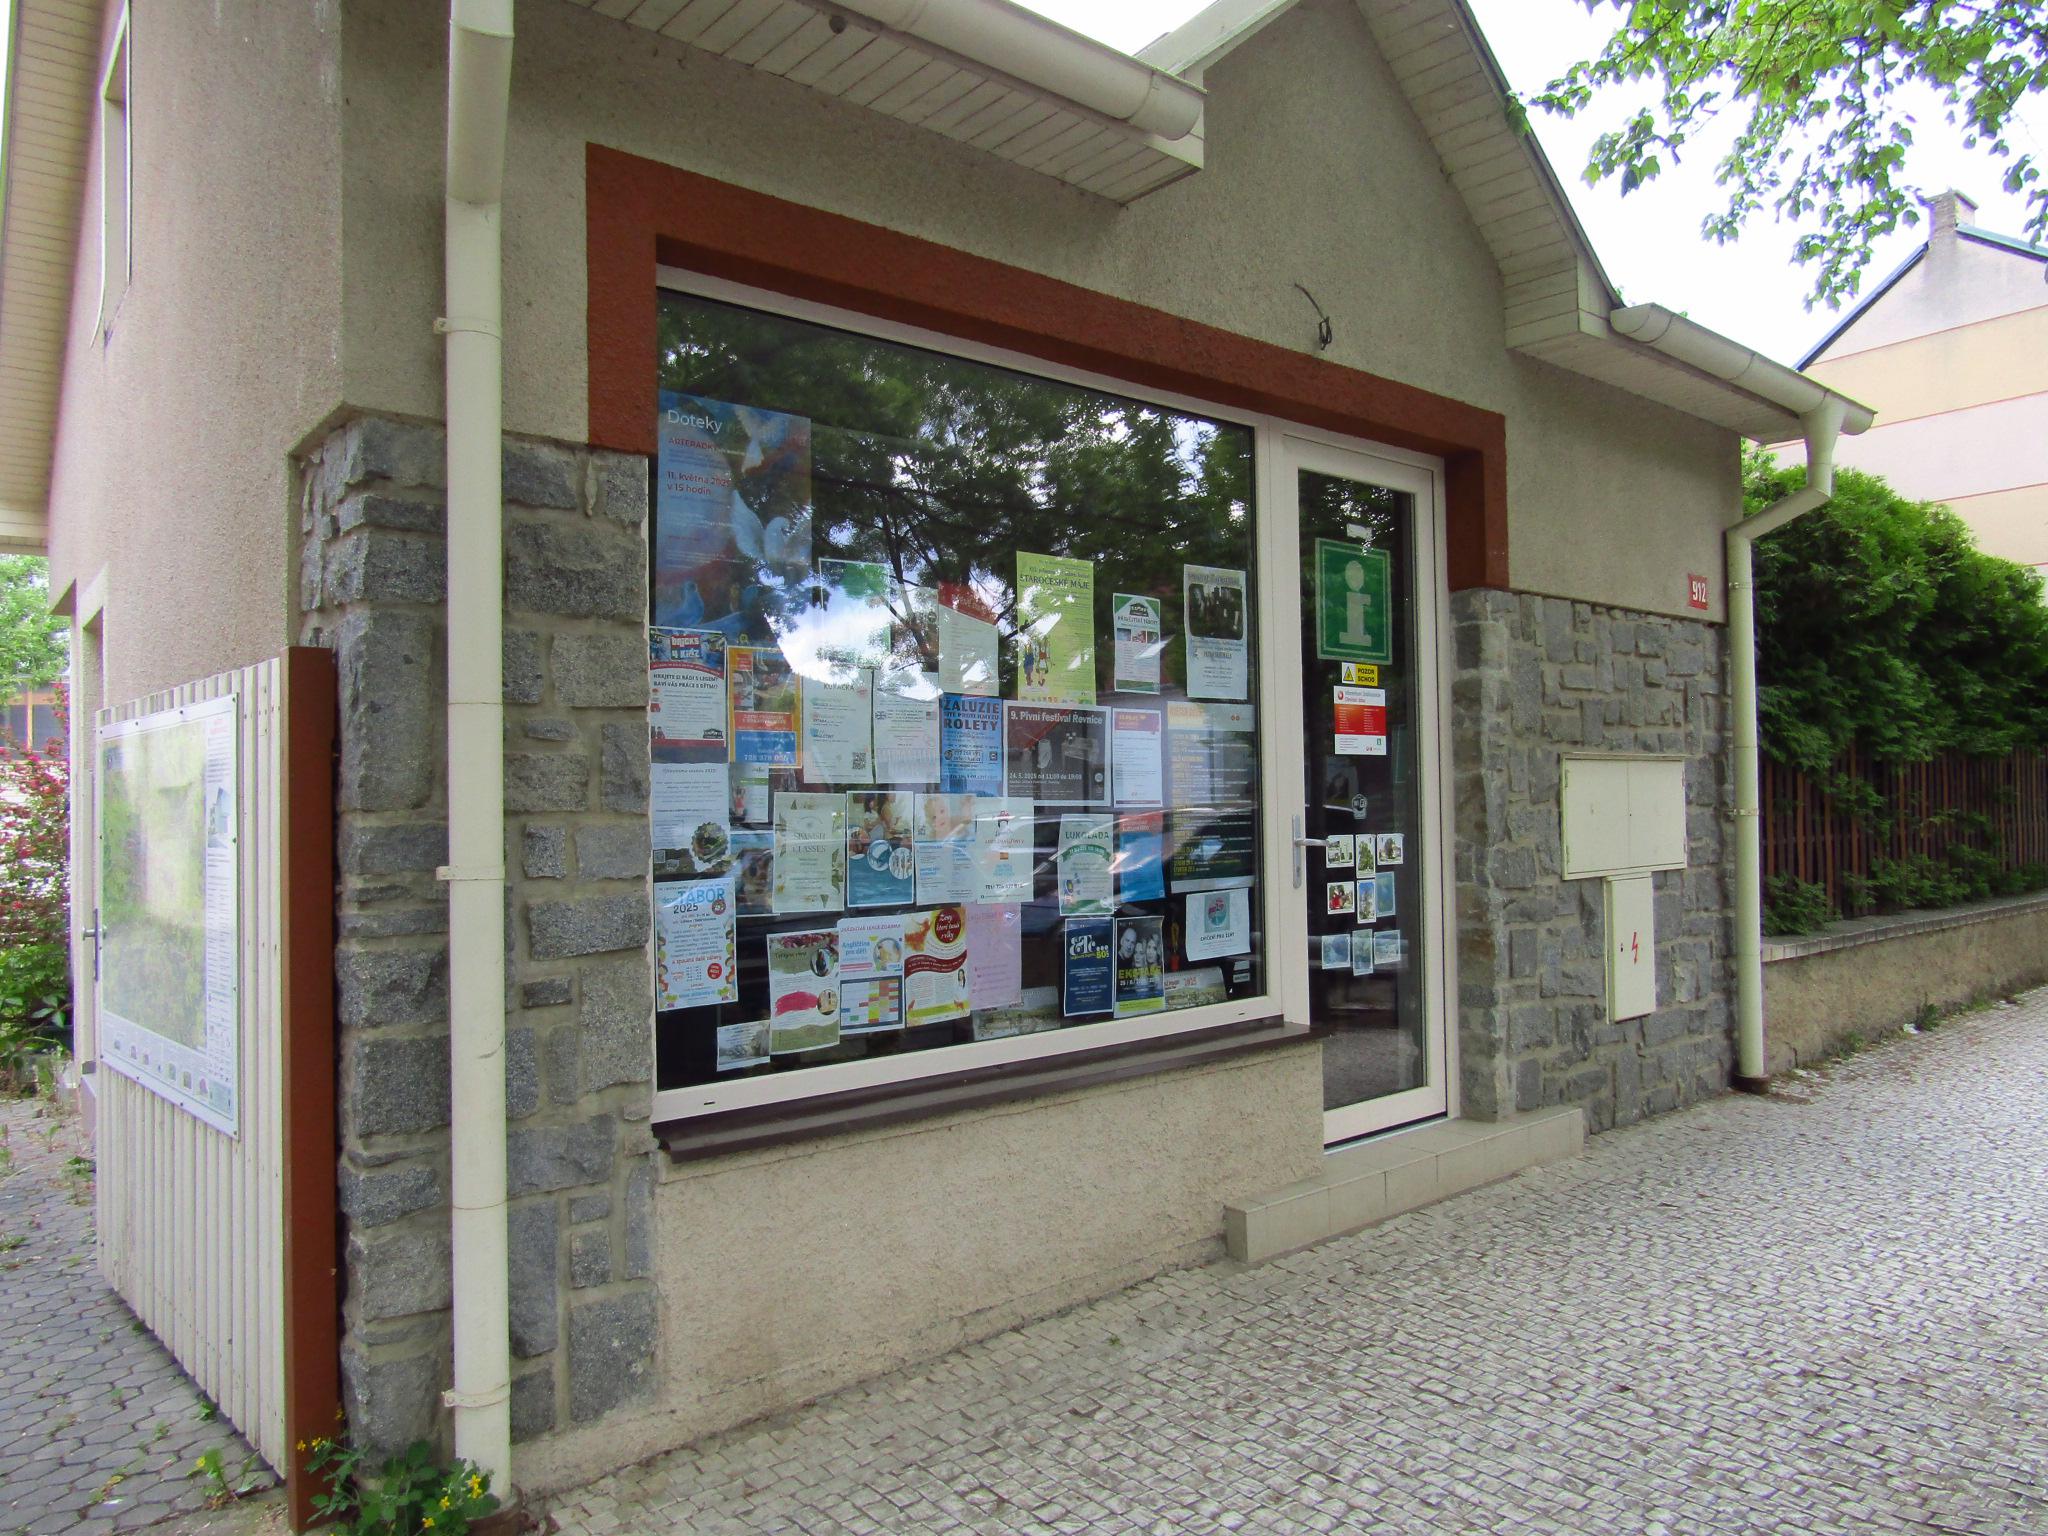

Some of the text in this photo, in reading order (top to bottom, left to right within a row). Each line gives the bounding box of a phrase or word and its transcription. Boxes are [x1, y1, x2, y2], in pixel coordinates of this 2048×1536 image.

[668, 409, 722, 434] Doteky
[675, 483, 684, 491] 15
[686, 484, 711, 494] hodin
[1692, 580, 1706, 602] 912
[1357, 667, 1375, 675] POZOR
[1357, 675, 1375, 683] SCHOD
[1011, 711, 1018, 720] 9.
[1020, 711, 1040, 721] Pivní
[1042, 712, 1071, 723] festival
[944, 718, 998, 731] ROLETY
[792, 845, 826, 853] CLASSES
[673, 903, 698, 914] 2025
